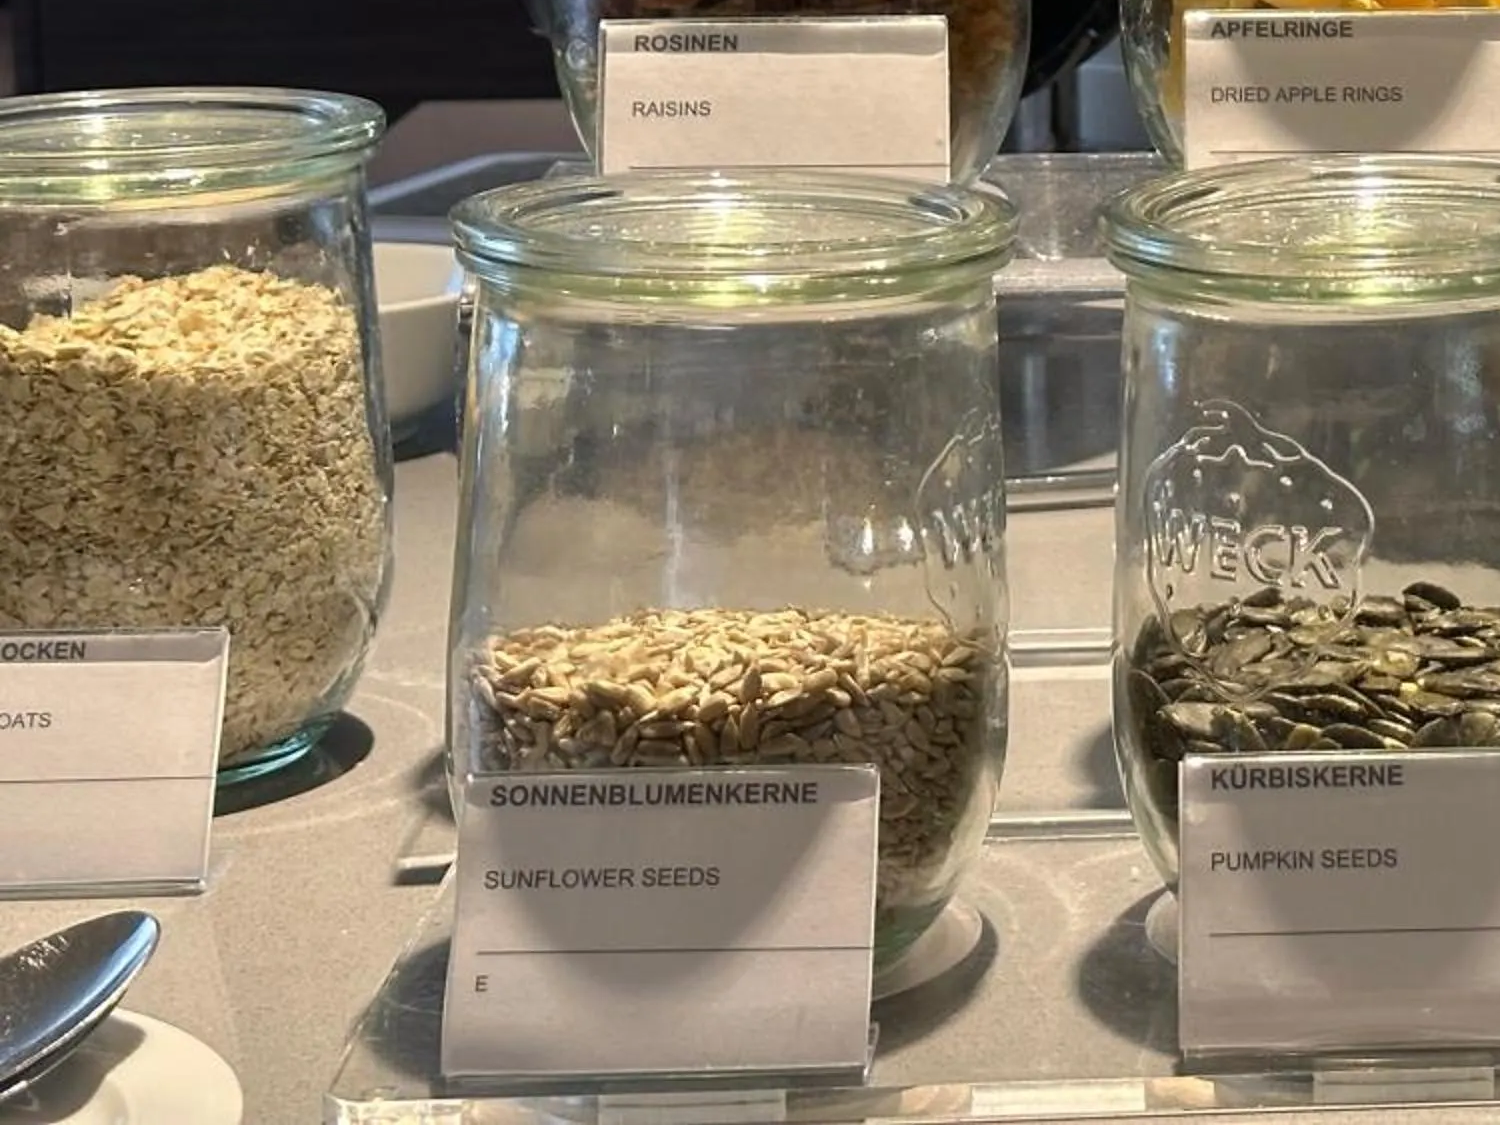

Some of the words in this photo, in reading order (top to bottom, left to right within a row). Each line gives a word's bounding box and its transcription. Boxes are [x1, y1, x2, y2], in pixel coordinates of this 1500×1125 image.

[1211, 20, 1354, 39] APFELRINGE
[634, 33, 738, 52] ROSINEN
[1211, 86, 1270, 104] DRIED
[1275, 85, 1337, 103] APPLE
[1343, 85, 1403, 103] RINGS
[632, 101, 711, 118] RAISINS
[1150, 505, 1343, 590] WECK
[0, 711, 53, 730] OATS
[1211, 764, 1405, 790] KÜRBISKERNE
[490, 782, 819, 808] SONNENBLUMENKERNE
[1211, 850, 1314, 872] PUMPKIN
[1321, 848, 1398, 869] SEEDS
[484, 869, 635, 890] SUNFLOWER
[641, 867, 721, 888] SEEDS
[475, 975, 489, 993] E
